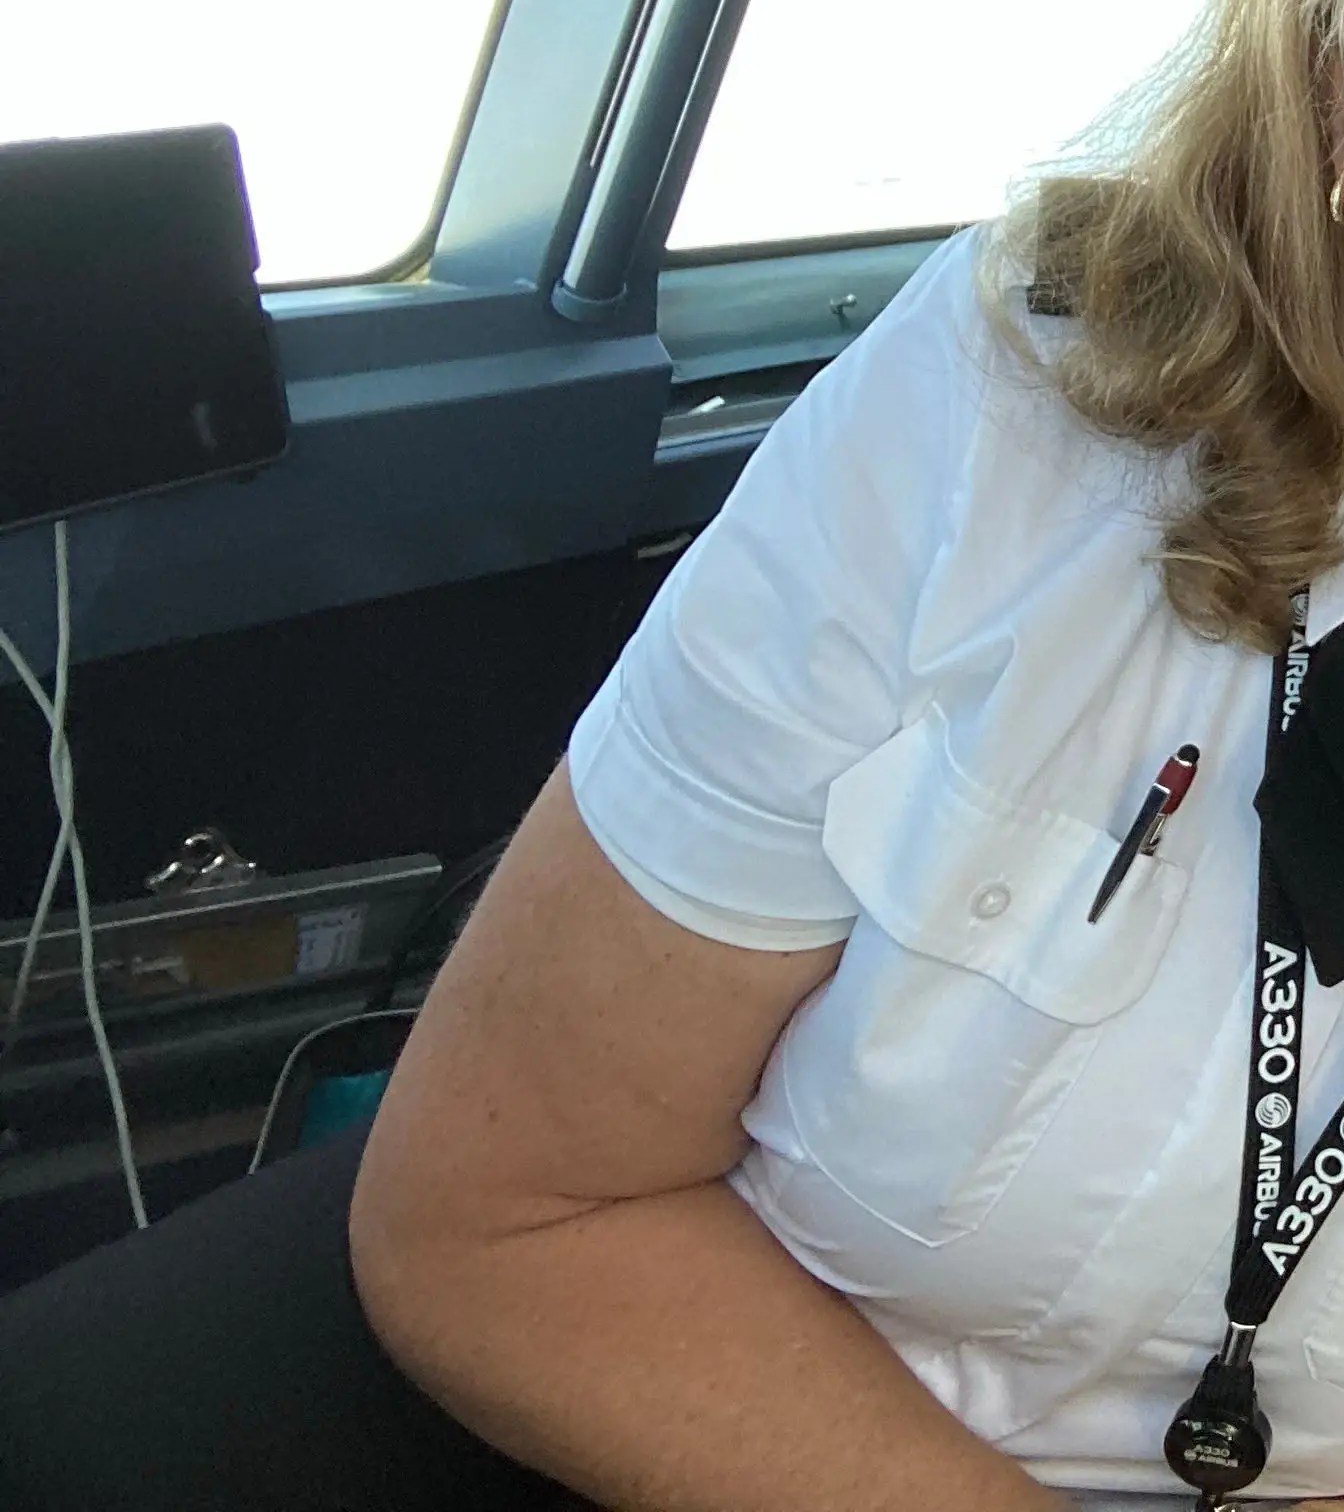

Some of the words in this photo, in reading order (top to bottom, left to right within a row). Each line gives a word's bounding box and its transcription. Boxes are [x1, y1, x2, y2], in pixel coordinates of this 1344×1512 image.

[1282, 629, 1310, 732] AIRBU
[1258, 941, 1298, 1084] A330
[1253, 1131, 1283, 1238] AIRBU
[1193, 1444, 1231, 1458] A330
[1197, 1455, 1239, 1468] AIRBUS
